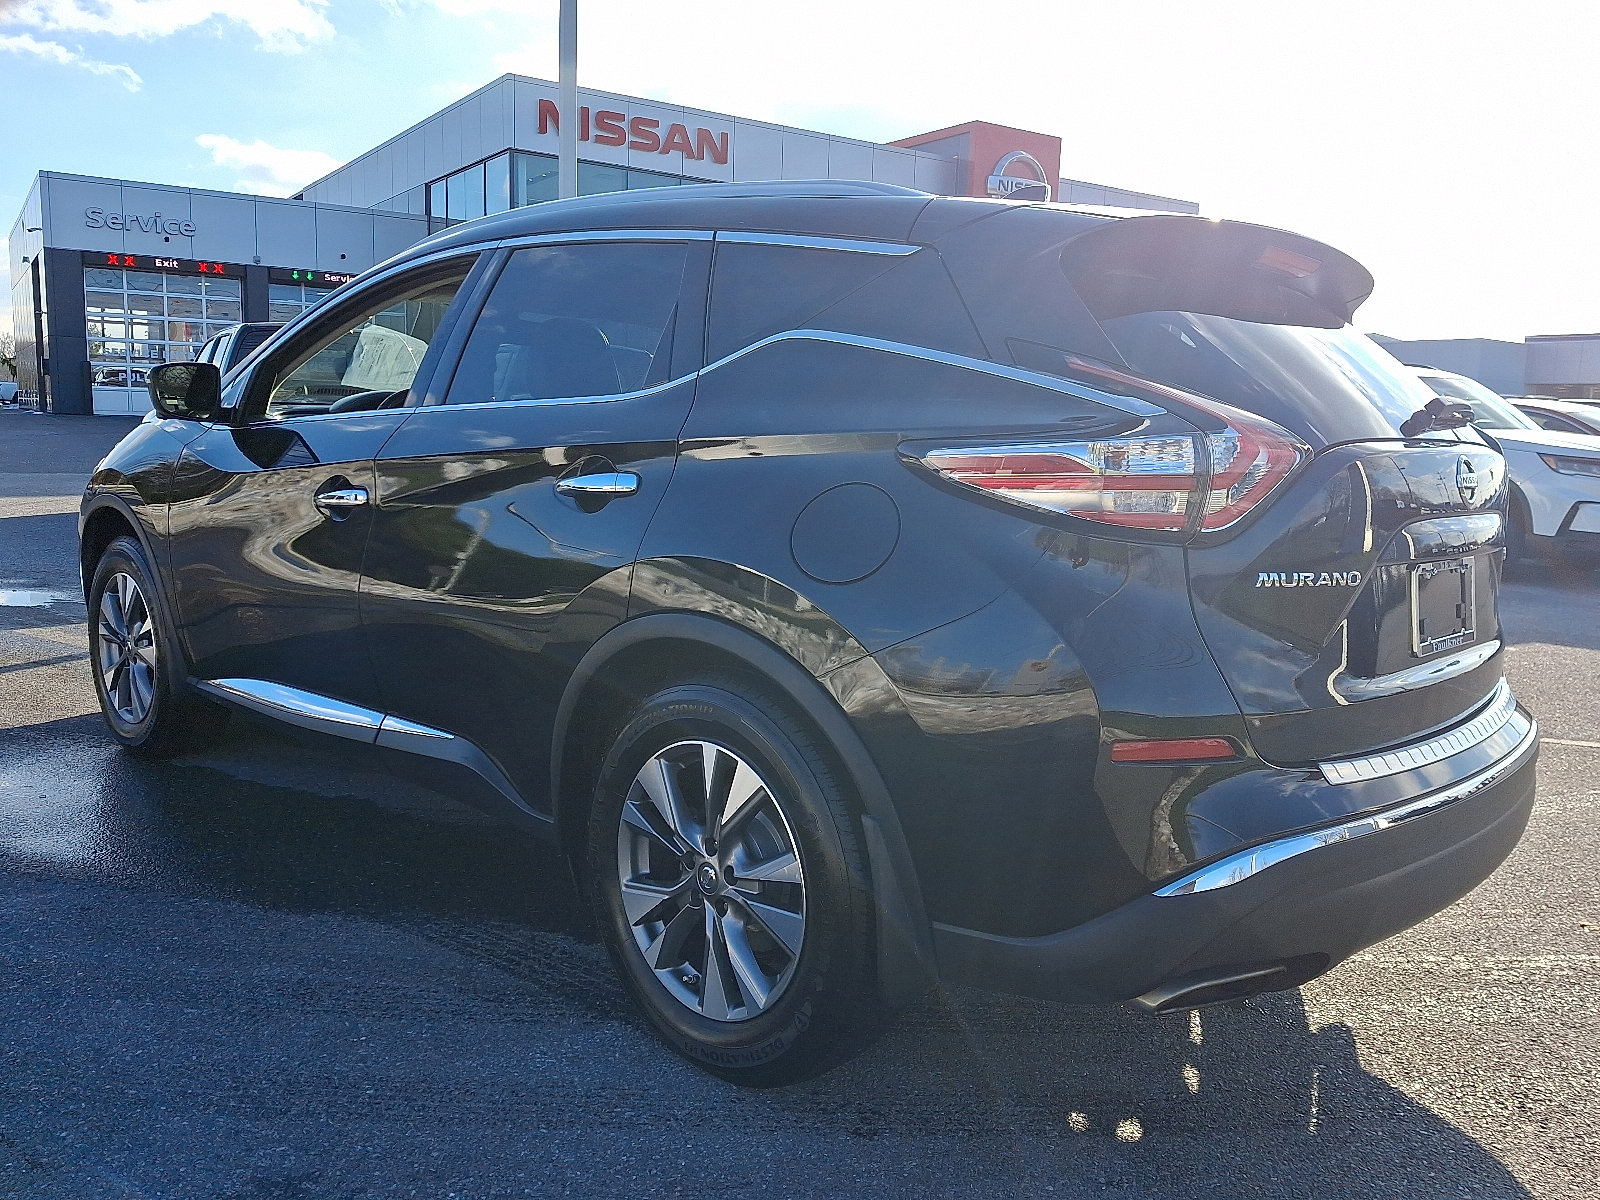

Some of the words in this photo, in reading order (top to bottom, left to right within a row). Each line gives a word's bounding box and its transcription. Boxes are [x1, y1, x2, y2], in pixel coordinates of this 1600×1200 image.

[538, 98, 729, 165] NISSAN
[85, 206, 197, 237] Service
[155, 258, 179, 268] Exit
[1255, 570, 1362, 588] MURANO
[1433, 637, 1464, 652] Faulkner
